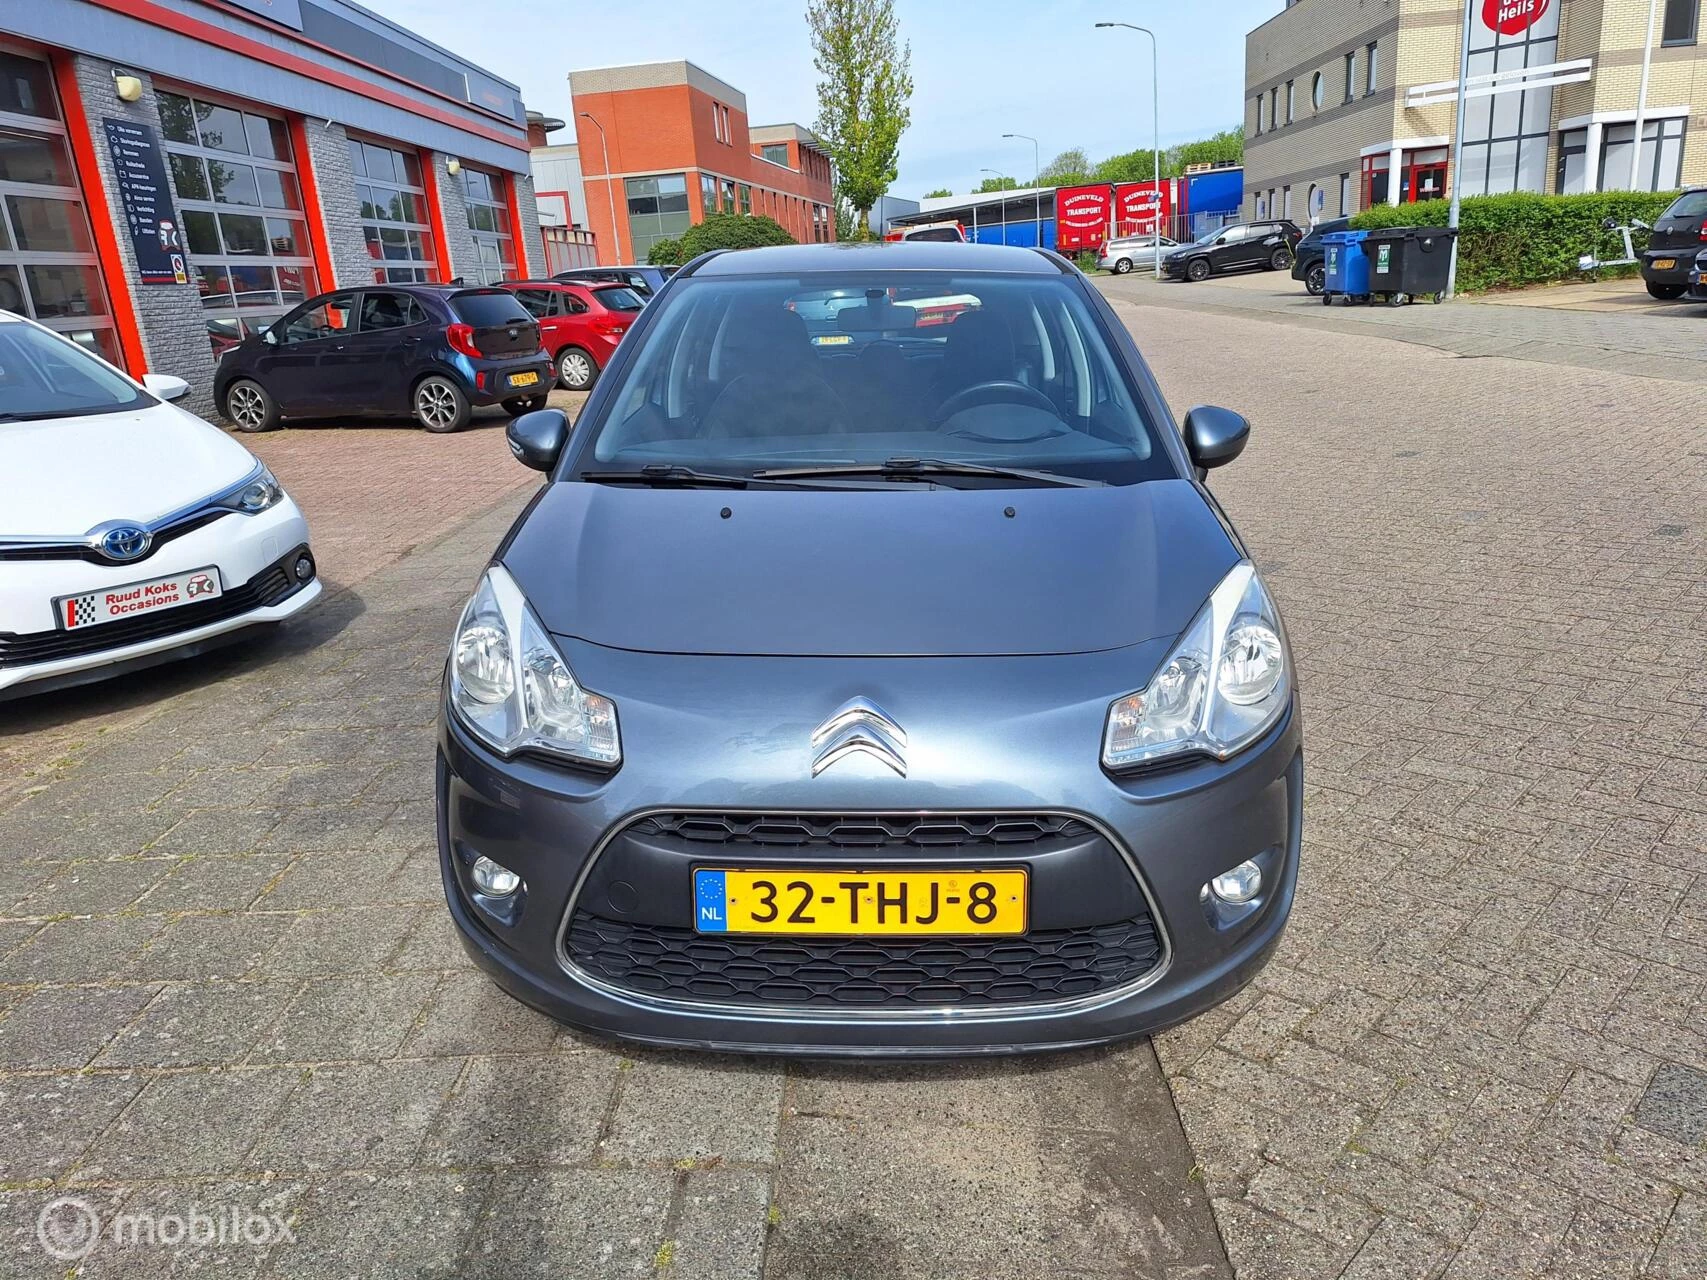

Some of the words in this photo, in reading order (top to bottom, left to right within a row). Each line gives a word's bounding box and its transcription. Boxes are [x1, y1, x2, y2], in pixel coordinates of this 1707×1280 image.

[1498, 0, 1534, 23] Heils
[1064, 194, 1104, 207] DUINEVELD
[1124, 190, 1163, 203] DUINEVED
[1066, 206, 1101, 216] TRANSPORT
[105, 588, 141, 605] Ruud
[144, 582, 178, 597] Koks
[109, 592, 180, 616] Occasions
[750, 881, 998, 925] 32-THJ-8
[701, 906, 723, 921] NL
